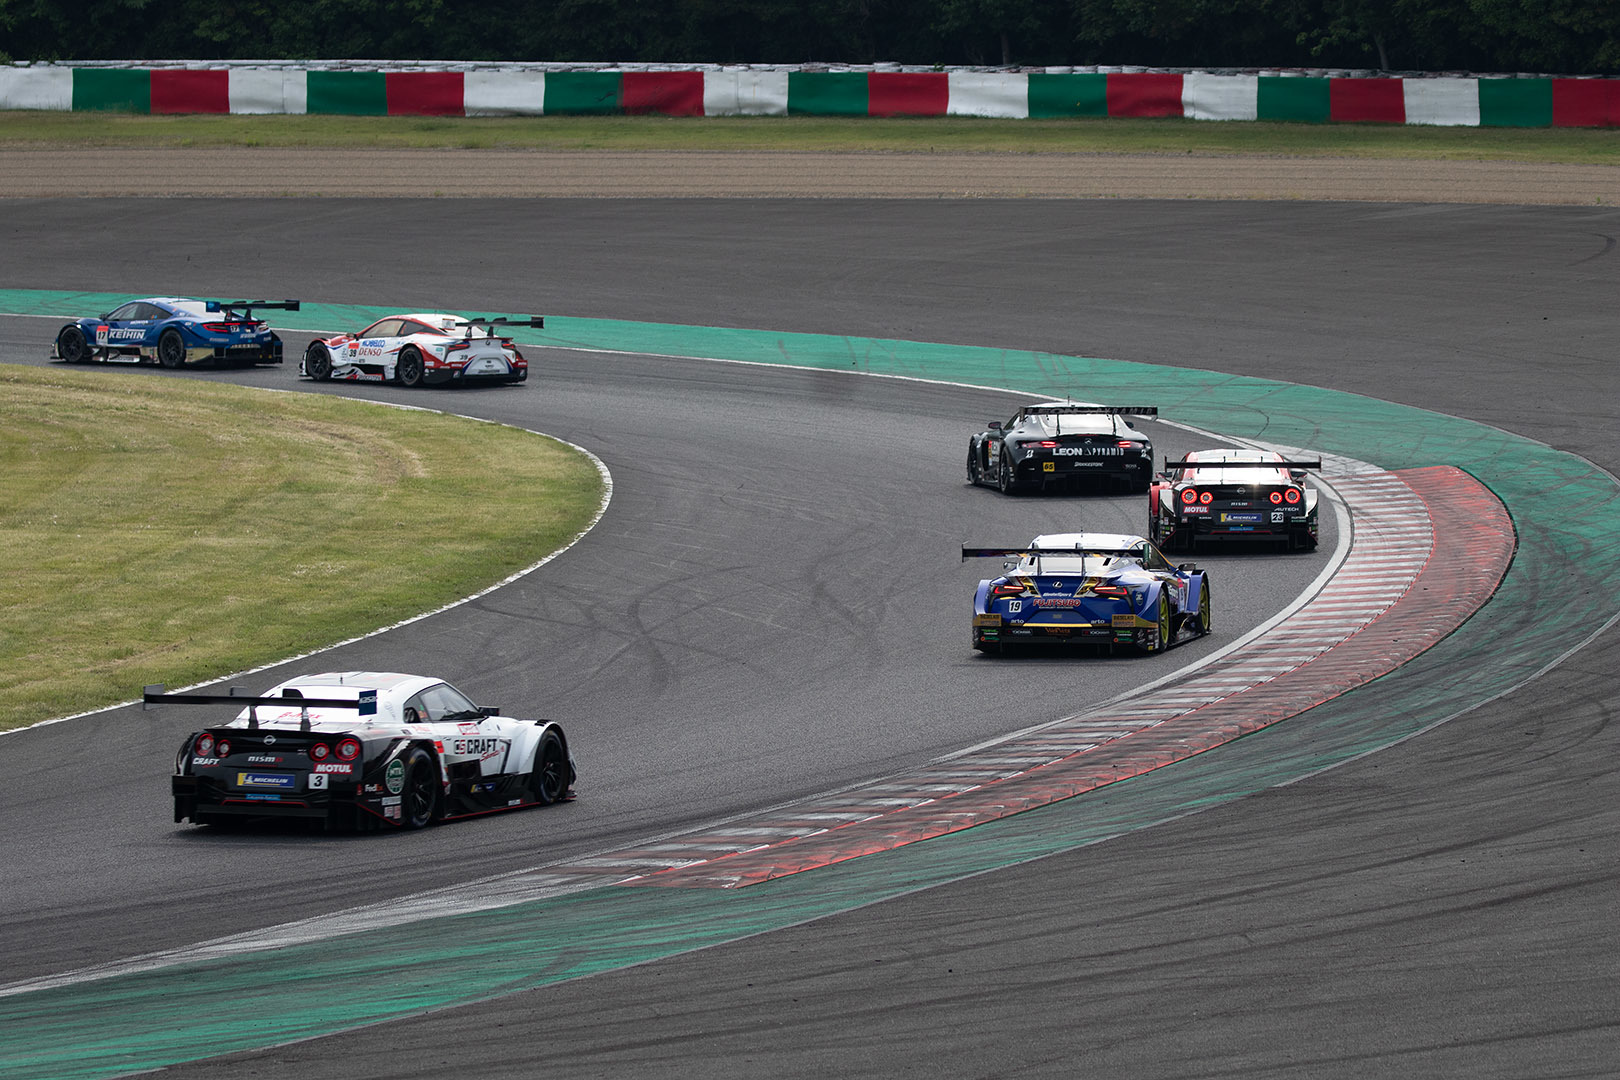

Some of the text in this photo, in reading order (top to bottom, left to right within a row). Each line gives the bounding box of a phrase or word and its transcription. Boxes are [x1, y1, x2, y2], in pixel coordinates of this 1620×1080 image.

[98, 331, 106, 340] 17
[358, 348, 382, 357] DENSO
[1052, 447, 1125, 456] LEON PYRAMID
[1272, 513, 1283, 521] 23
[1010, 601, 1021, 612] 19
[1032, 598, 1082, 607] FUJITSUBO
[467, 739, 498, 754] CRAFT
[192, 757, 220, 766] CRAFT
[315, 764, 353, 773] MOTUL
[314, 775, 324, 788] 3
[364, 783, 384, 792] FedEx
